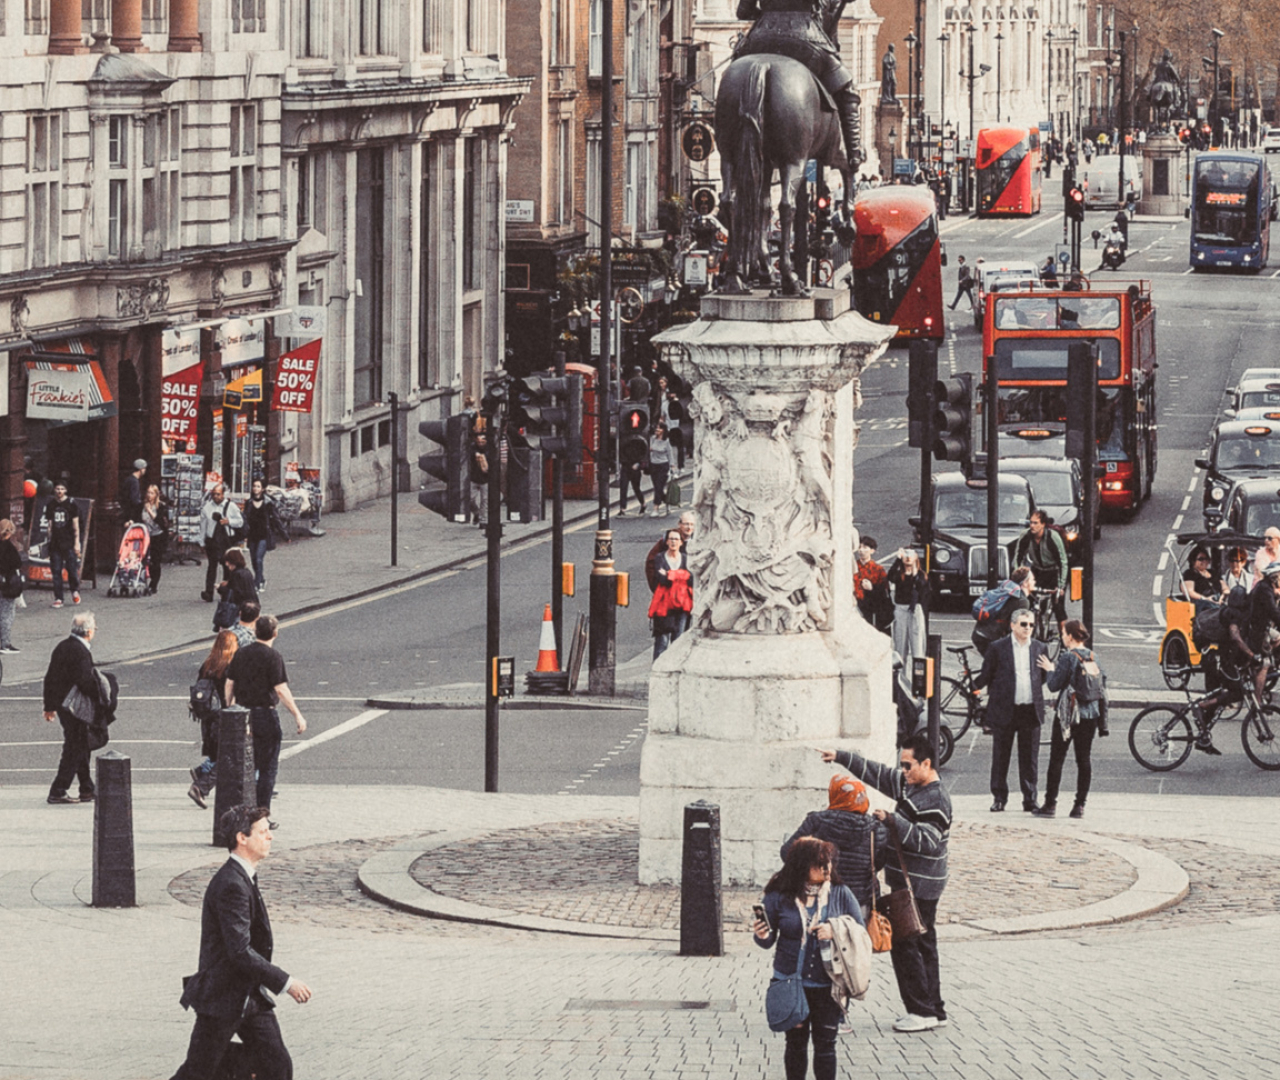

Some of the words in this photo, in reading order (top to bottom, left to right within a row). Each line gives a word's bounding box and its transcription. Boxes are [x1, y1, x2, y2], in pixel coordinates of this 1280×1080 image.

[281, 358, 314, 371] SALE
[277, 372, 313, 391] 50%
[30, 380, 86, 405] Frankie's
[162, 382, 198, 397] SALE
[280, 391, 306, 405] OFF
[162, 398, 197, 418] 50%
[162, 418, 190, 433] OFF
